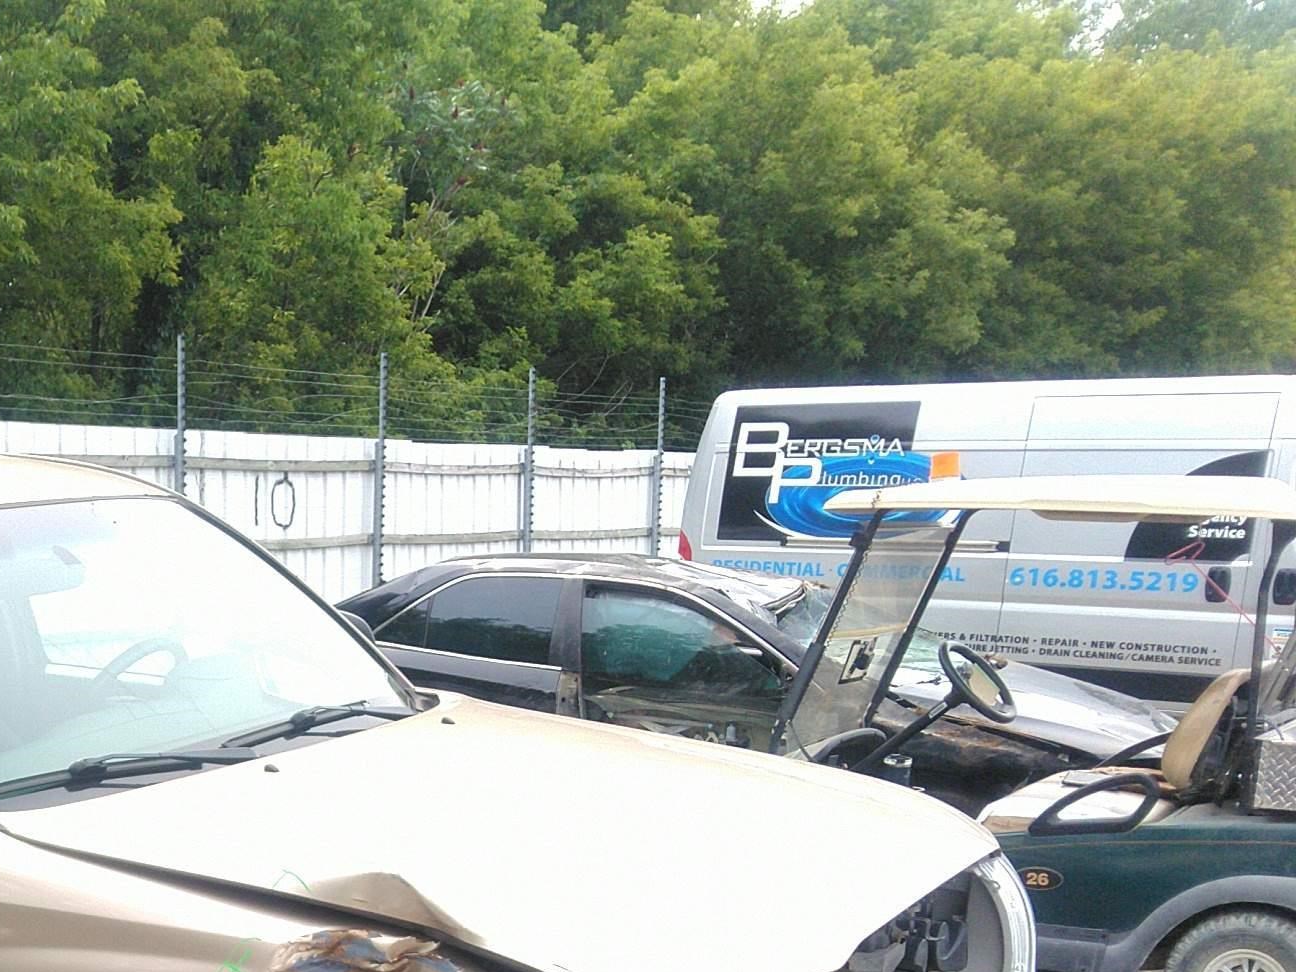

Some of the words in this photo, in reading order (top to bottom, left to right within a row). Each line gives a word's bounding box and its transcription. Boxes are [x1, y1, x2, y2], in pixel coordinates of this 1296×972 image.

[1188, 525, 1245, 539] Service
[1010, 567, 1198, 592] 616.813.5219
[969, 633, 1029, 644] FILTRATION
[1041, 637, 1079, 648] REPAIR
[1091, 640, 1115, 650] NEW
[1119, 641, 1209, 655] CONSTRUCTION
[989, 644, 1029, 655] JETTING
[1039, 647, 1070, 657] DRAIN
[1177, 656, 1222, 667] SERVICE
[1026, 872, 1049, 886] 26
